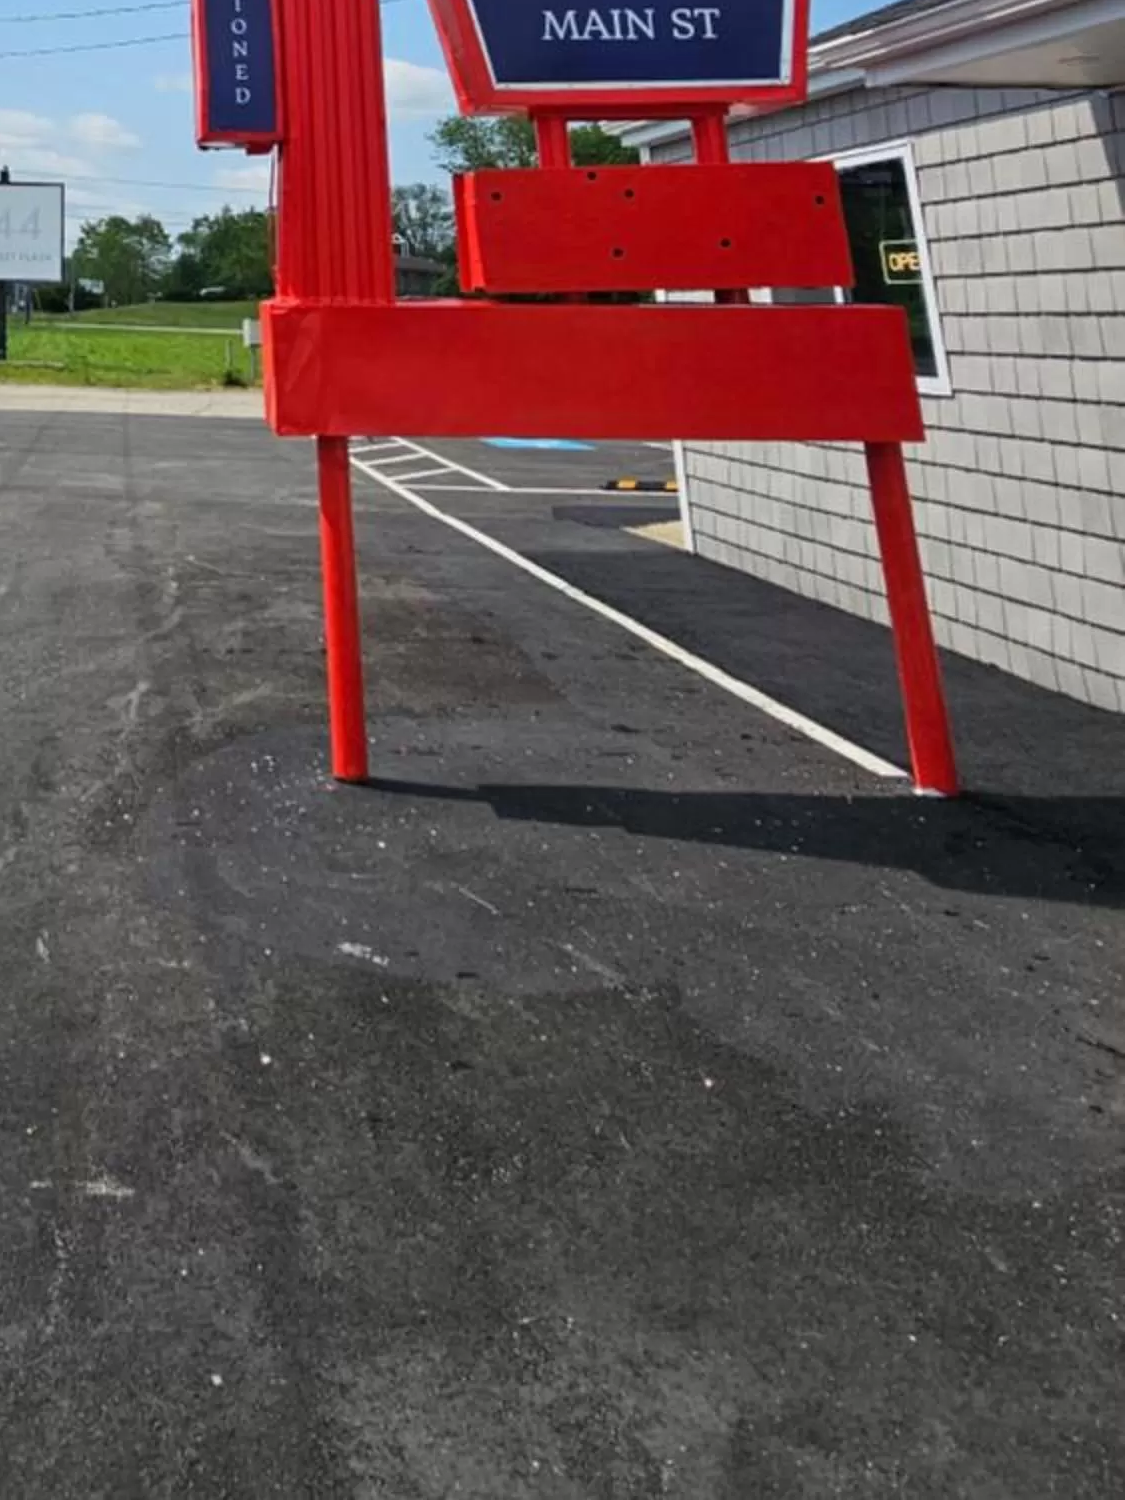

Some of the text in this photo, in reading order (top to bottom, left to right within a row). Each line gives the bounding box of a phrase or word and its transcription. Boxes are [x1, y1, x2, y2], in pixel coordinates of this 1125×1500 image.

[541, 7, 721, 41] MAIN ST
[888, 252, 921, 271] OPE
